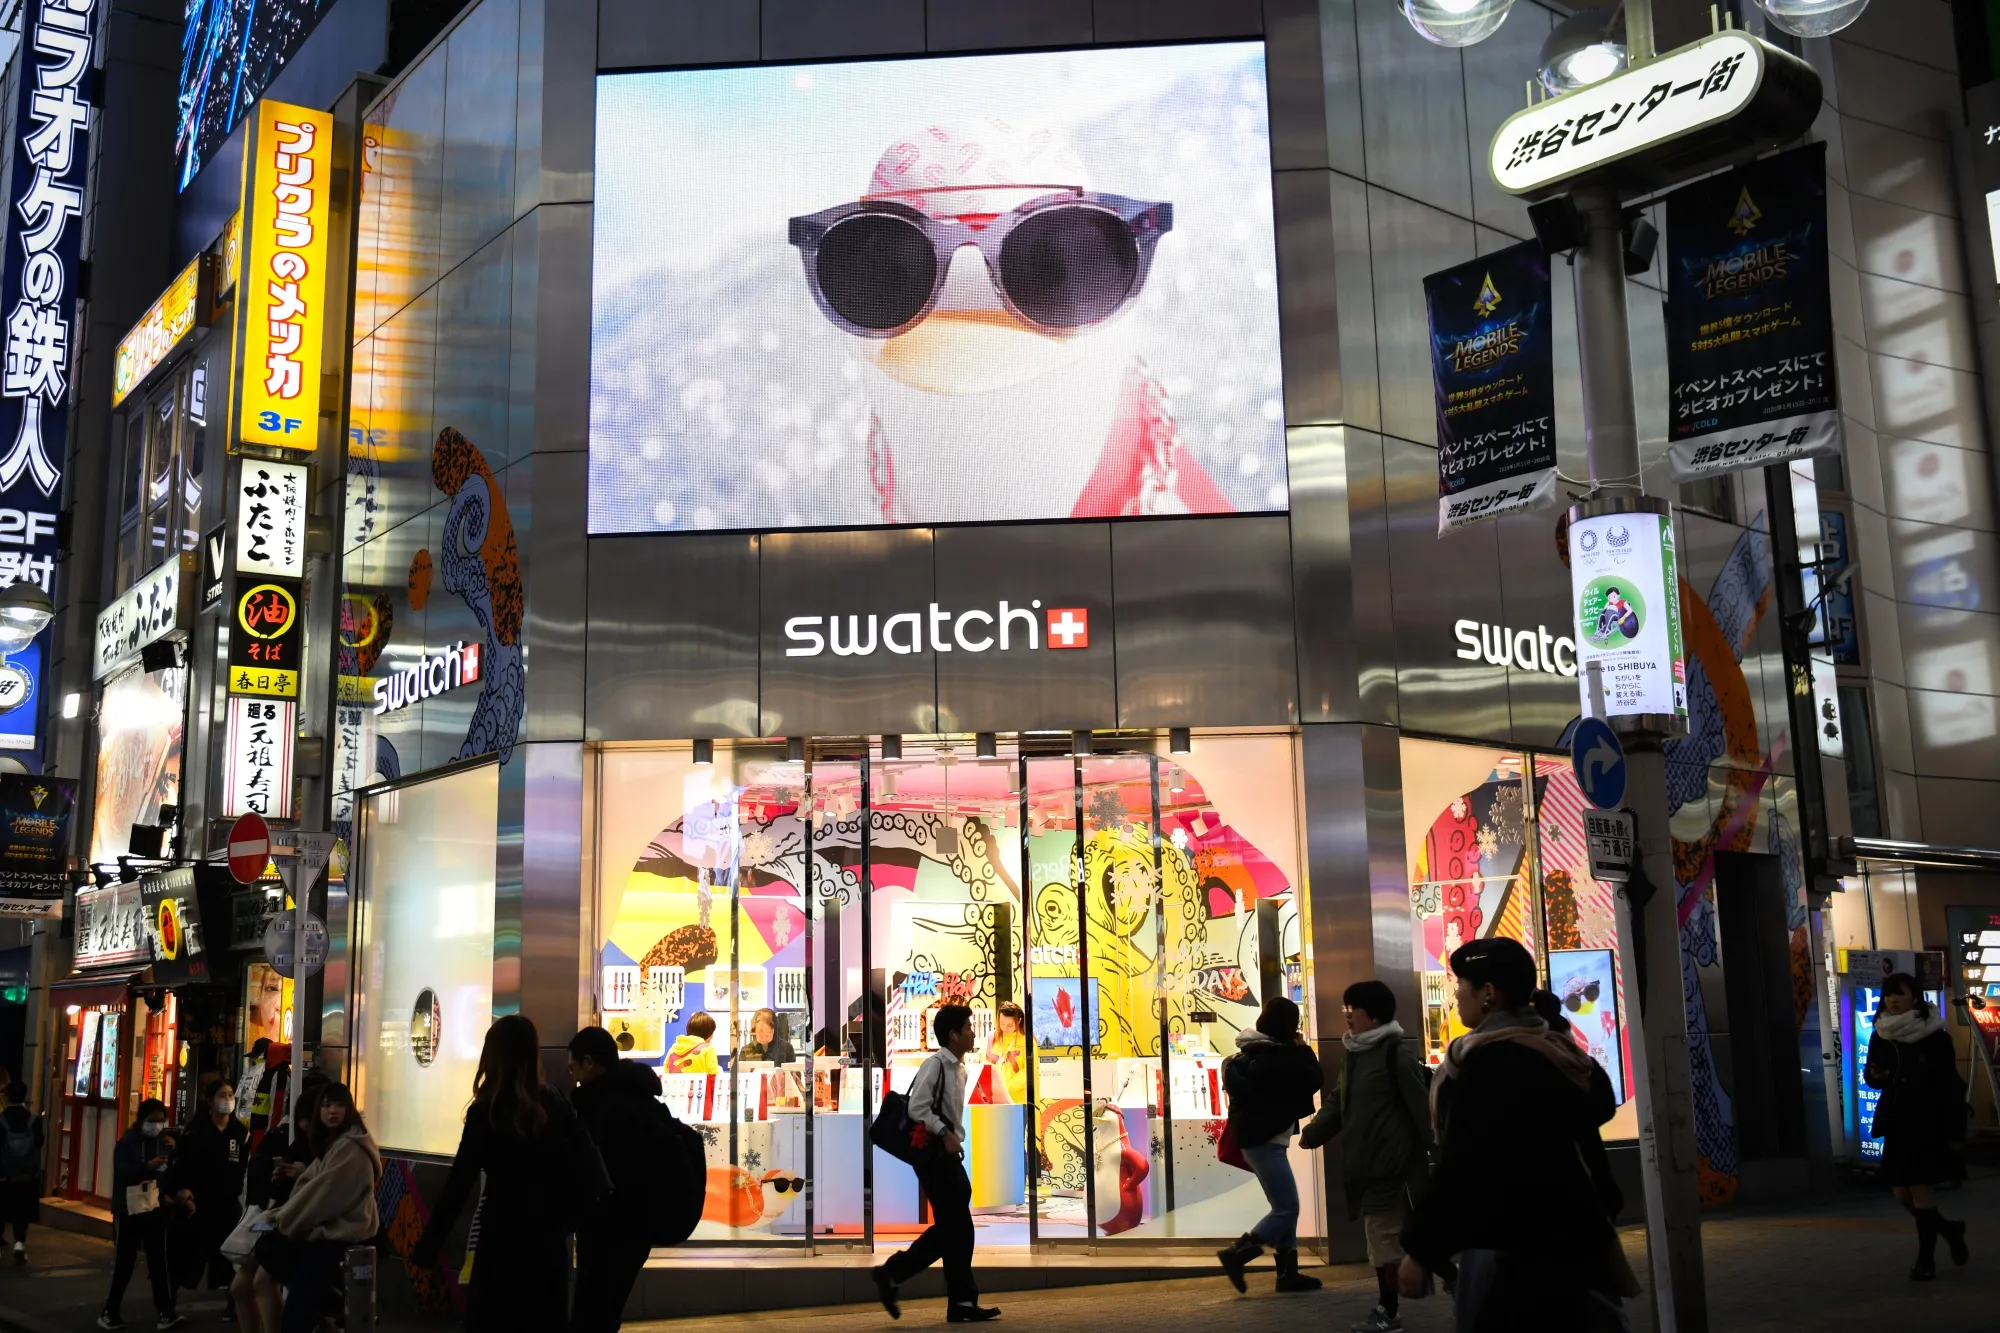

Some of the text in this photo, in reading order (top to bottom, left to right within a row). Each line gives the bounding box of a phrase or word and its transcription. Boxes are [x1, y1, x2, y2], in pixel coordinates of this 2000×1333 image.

[1505, 52, 1746, 171] 渋谷センター街
[264, 120, 316, 400] プリクラのメッカ
[1706, 243, 1790, 282] MOBILE
[1706, 261, 1787, 301] LEGENDS
[1453, 322, 1520, 358] MOBILE
[1453, 338, 1519, 373] LEGENDS
[1674, 351, 1828, 399] イベントスペースにて
[258, 411, 302, 434] 3F
[1439, 416, 1550, 460] イベントスペースにて
[1691, 425, 1810, 465] 渋谷センター街
[243, 469, 280, 561] ふたご
[1447, 483, 1537, 519] 渋谷センター街
[0, 508, 56, 545] 2F
[247, 593, 288, 628] 油
[784, 600, 1041, 657] swatch
[248, 643, 283, 661] そば
[1617, 662, 1657, 671] SHIBUYA
[236, 670, 291, 693] 春日亭
[373, 640, 464, 716] swatch
[1615, 674, 1641, 682] ちがいを
[1615, 682, 1641, 690] ちからに
[1616, 698, 1638, 707] 渋谷区
[245, 722, 274, 814] 元祖寿司
[14, 817, 56, 829] MOBILE
[14, 826, 55, 837] LEGENDS
[1588, 817, 1630, 838] 自転車を除く
[1592, 839, 1631, 857] 一方通行
[1966, 951, 1979, 961] 4F
[1973, 1010, 1995, 1024] BUY
